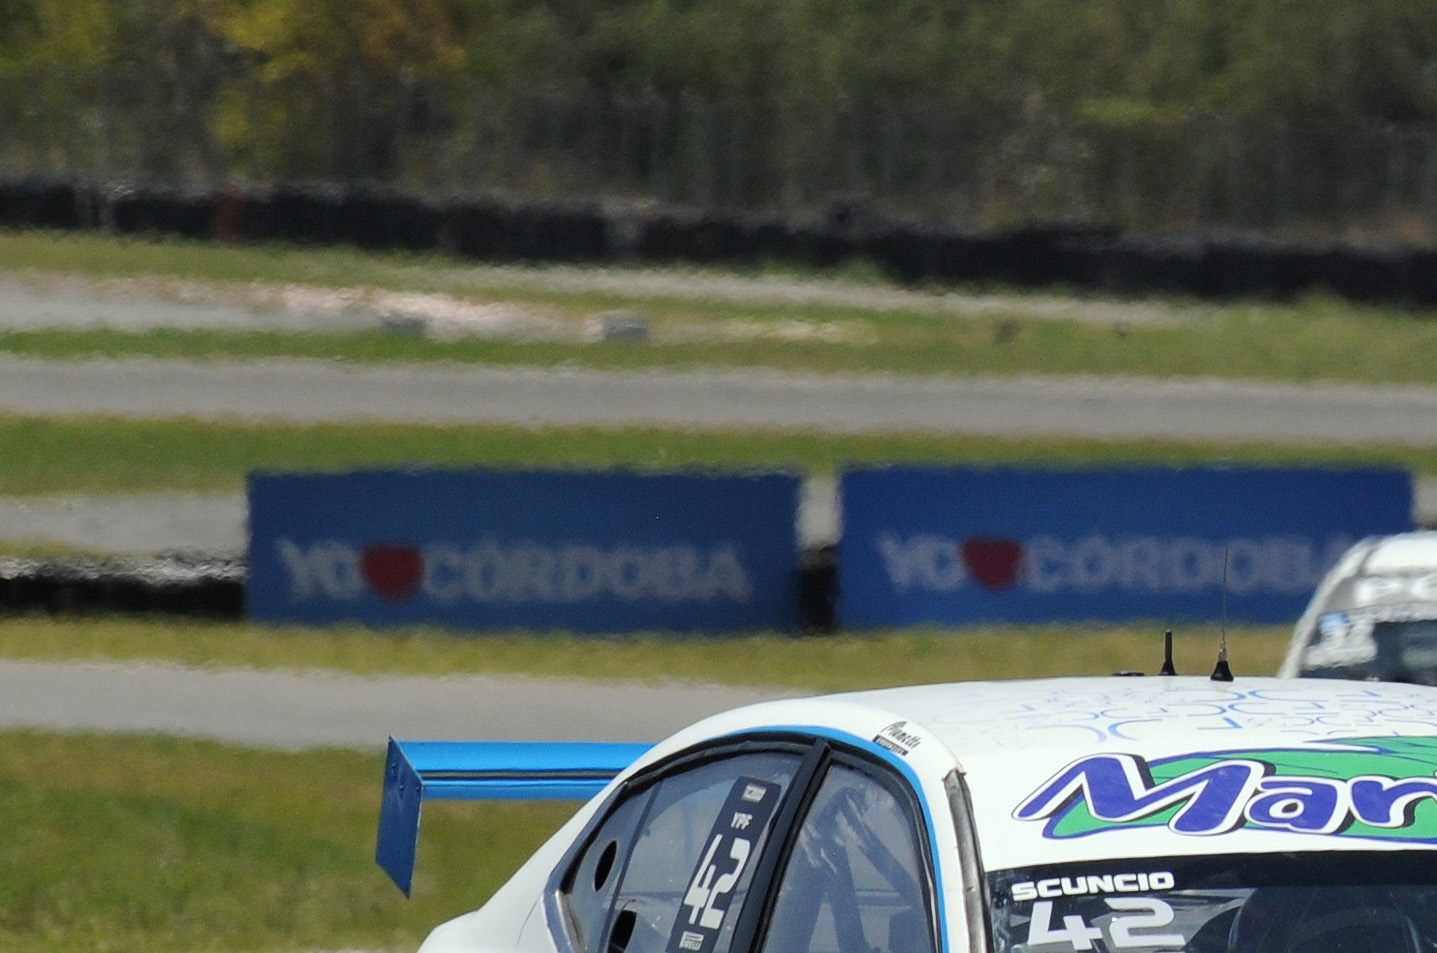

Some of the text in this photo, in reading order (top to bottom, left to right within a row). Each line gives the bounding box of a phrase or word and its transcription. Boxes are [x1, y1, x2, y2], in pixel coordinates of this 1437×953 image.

[730, 811, 753, 830] YPF
[684, 833, 750, 930] 42
[1011, 871, 1175, 901] SCUNCIO
[1027, 897, 1187, 951] 42
